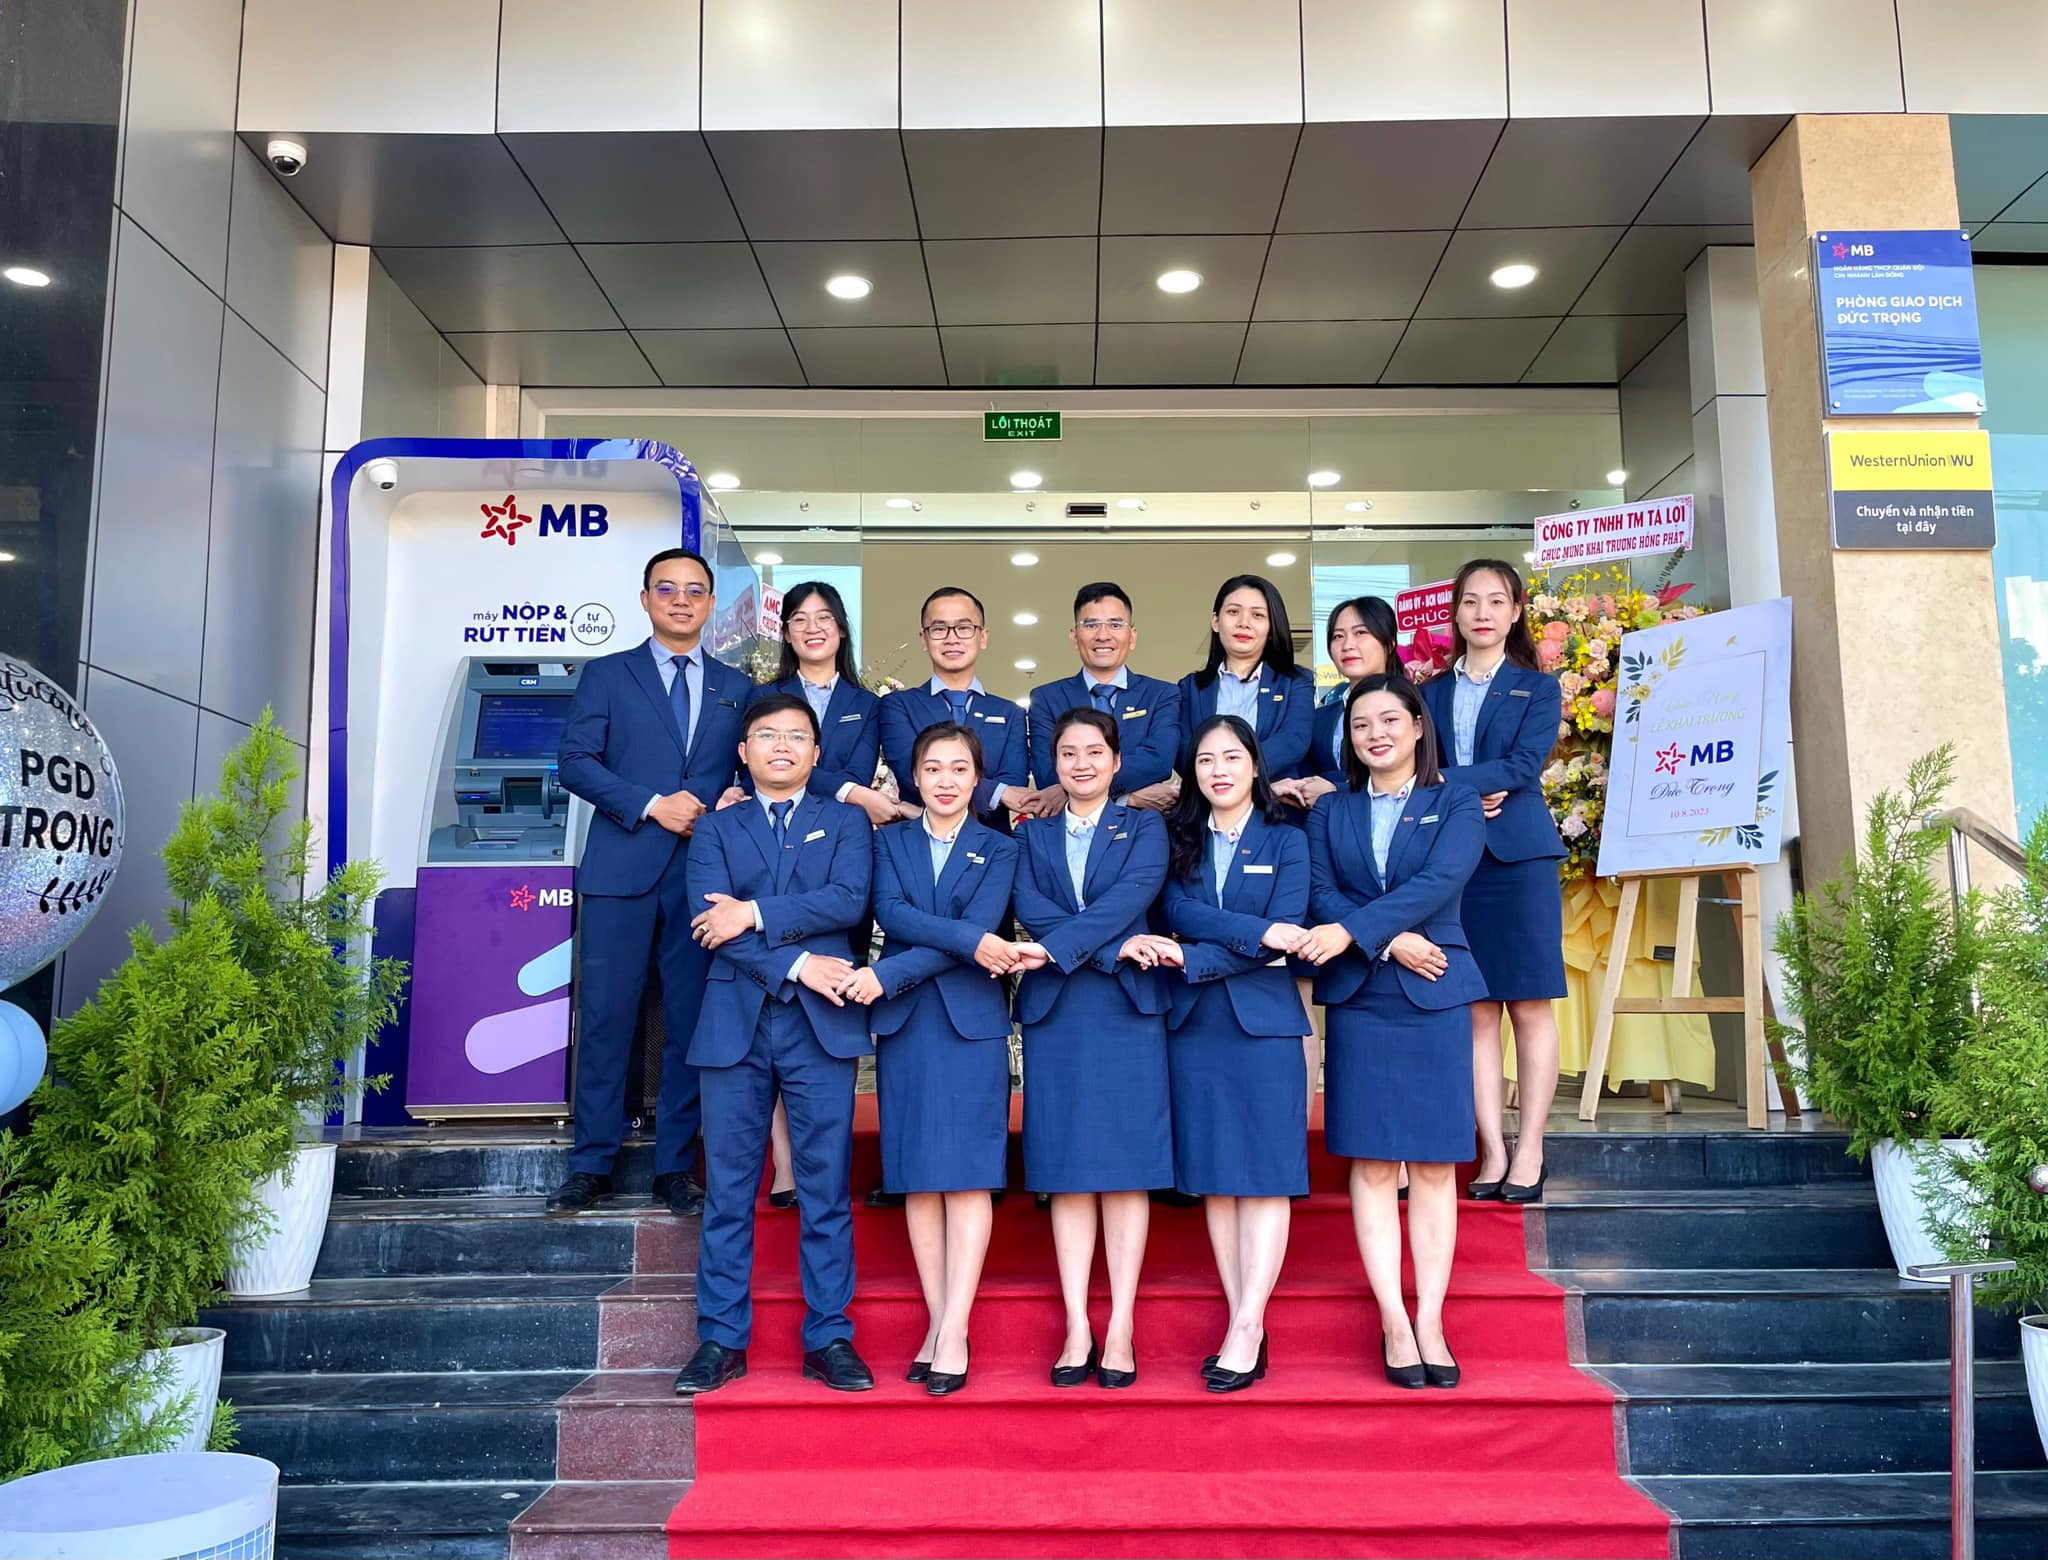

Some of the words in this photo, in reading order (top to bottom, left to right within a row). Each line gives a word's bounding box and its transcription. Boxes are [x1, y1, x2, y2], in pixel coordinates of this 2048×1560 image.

[1851, 244, 1874, 257] MB
[1836, 294, 1888, 308] PHÒNG
[1890, 296, 1926, 307] GIAO
[1928, 296, 1963, 310] DỊCH
[1837, 310, 1870, 324] ĐỨC
[1872, 312, 1922, 326] TRỌNG
[1013, 416, 1053, 429] THOÁT
[1850, 453, 1947, 467] WesternUnion
[1950, 455, 1974, 467] WU
[1856, 504, 1900, 519] Chuyển
[1903, 506, 1917, 517] và
[1919, 505, 1950, 519] nhận
[1951, 504, 1974, 517] tiền
[539, 504, 609, 537] MB
[1577, 519, 1590, 537] TY
[1593, 514, 1623, 534] TNHH
[1627, 511, 1644, 529] TM
[1896, 522, 1912, 534] tại
[1914, 521, 1937, 535] đây
[1586, 540, 1604, 556] KHAI
[473, 612, 498, 622] máy
[502, 601, 550, 624] NỘP
[553, 605, 567, 620] &
[764, 595, 781, 615] AMC
[587, 612, 600, 622] tự
[1402, 609, 1450, 627] CHÚC
[464, 624, 508, 642] RÚT
[514, 623, 566, 642] TIỀN
[577, 623, 608, 635] động
[1690, 740, 1734, 766] MB
[20, 749, 95, 800] PGD
[538, 889, 574, 907] MB
